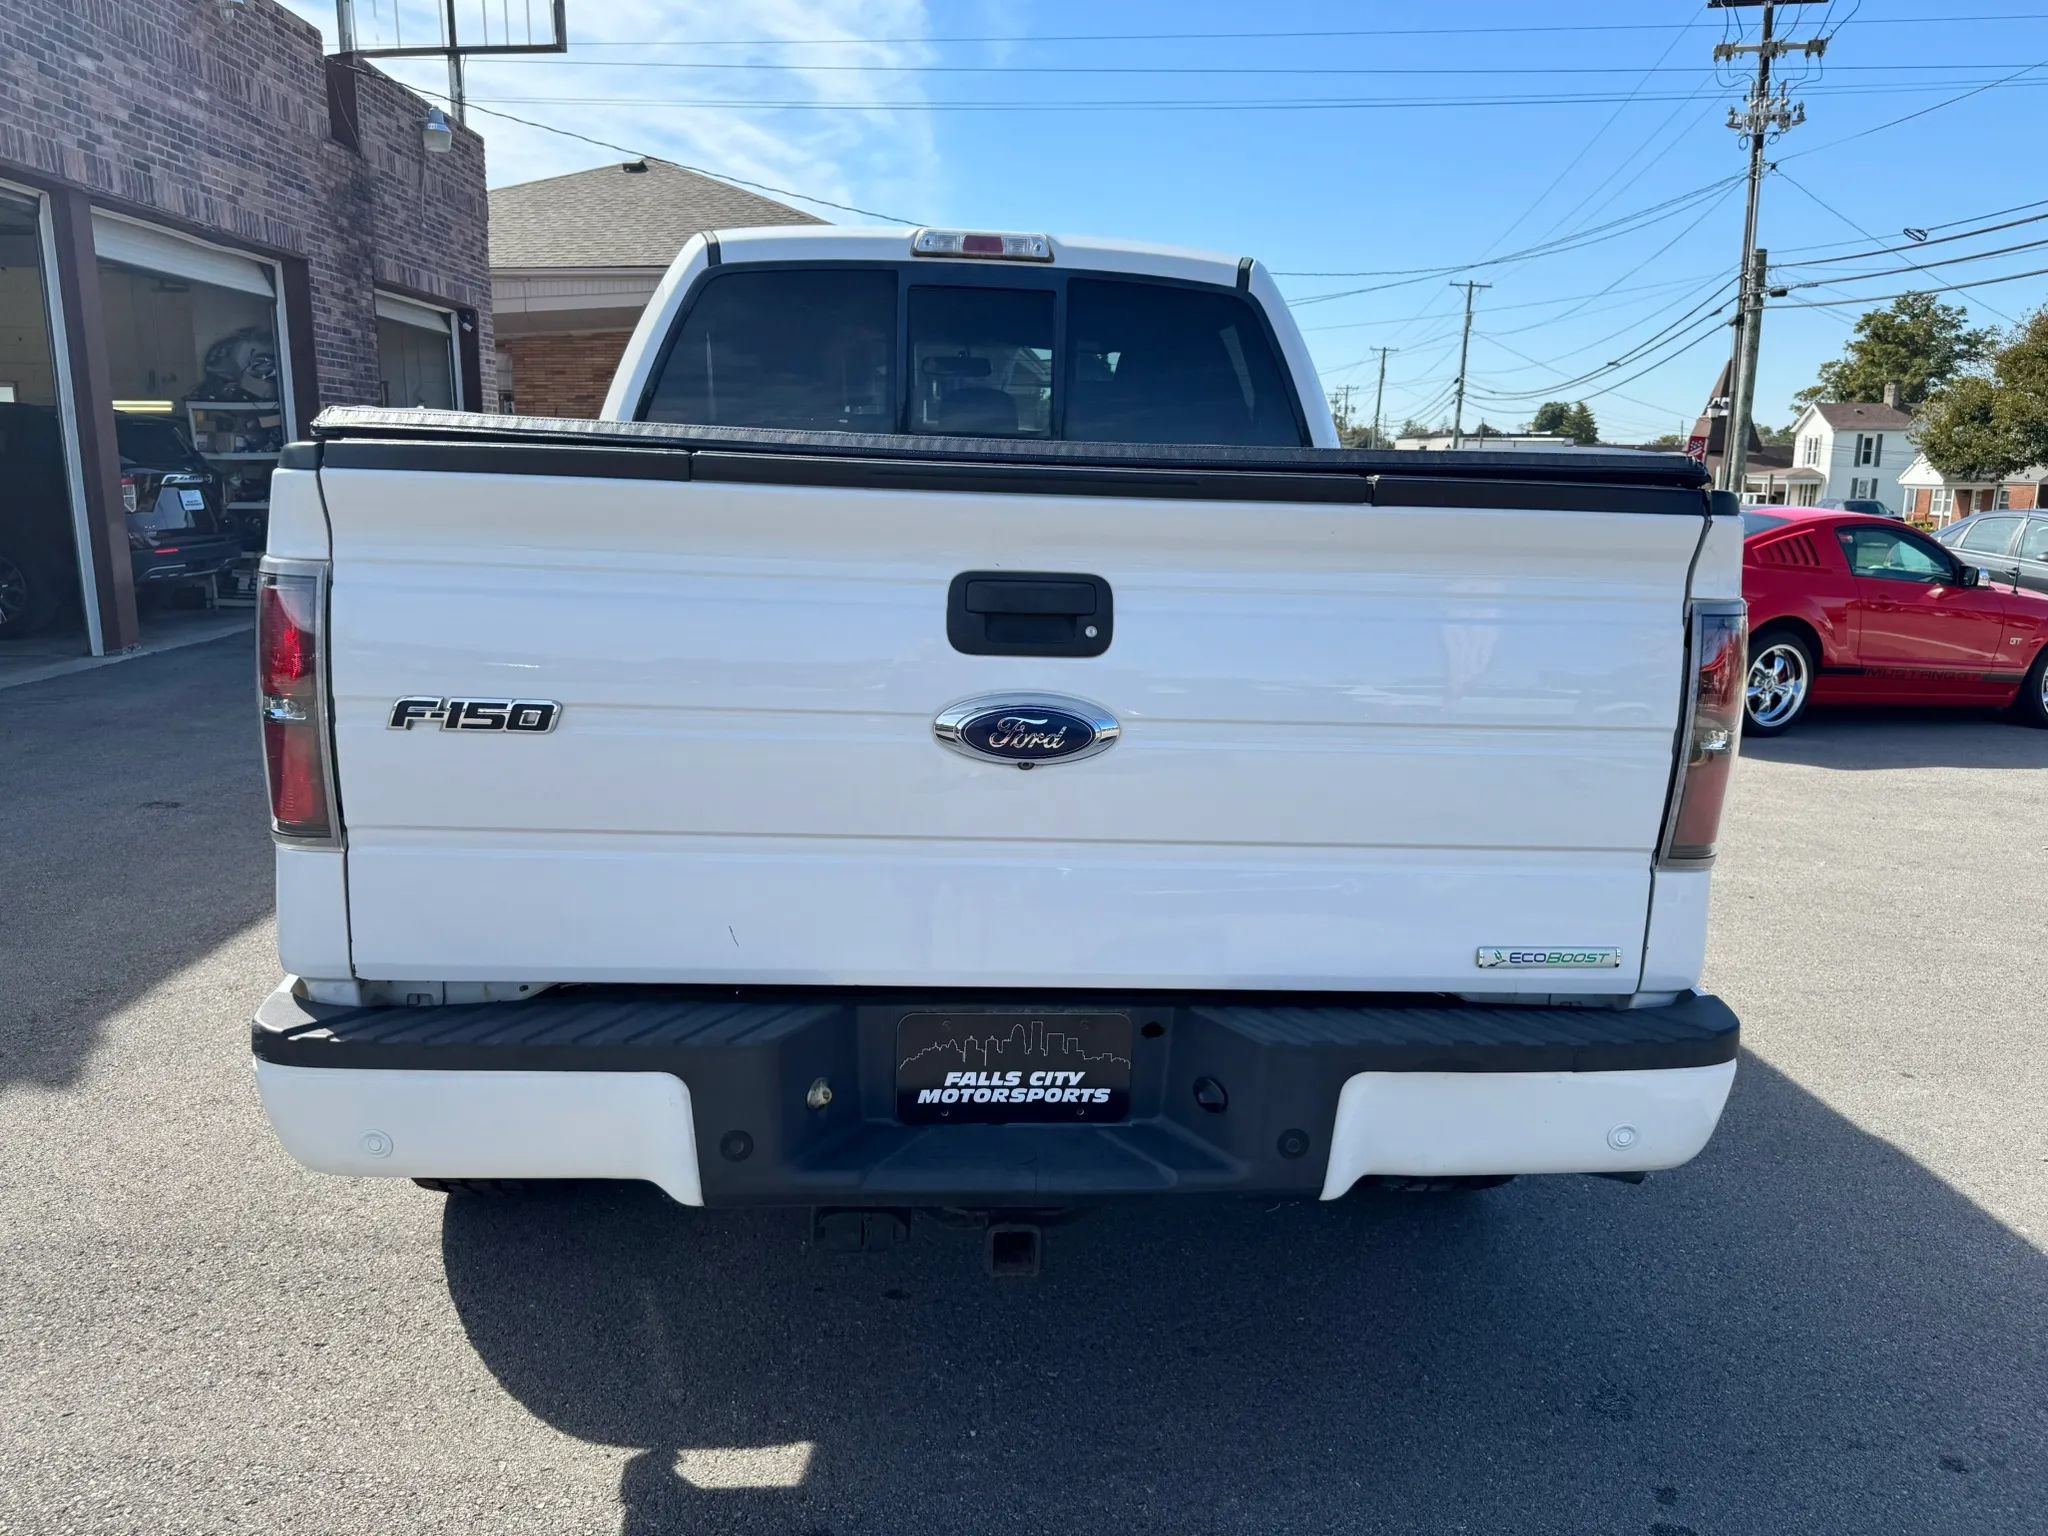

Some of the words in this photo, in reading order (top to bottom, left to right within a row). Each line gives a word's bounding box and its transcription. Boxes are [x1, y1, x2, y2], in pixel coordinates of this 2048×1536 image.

[2009, 637, 2023, 646] GT
[388, 696, 561, 733] F-150
[988, 716, 1066, 748] Ford
[944, 1071, 1022, 1086] FALLS
[1029, 1071, 1086, 1086] CITY
[917, 1088, 1111, 1104] MOTORSPORTS
